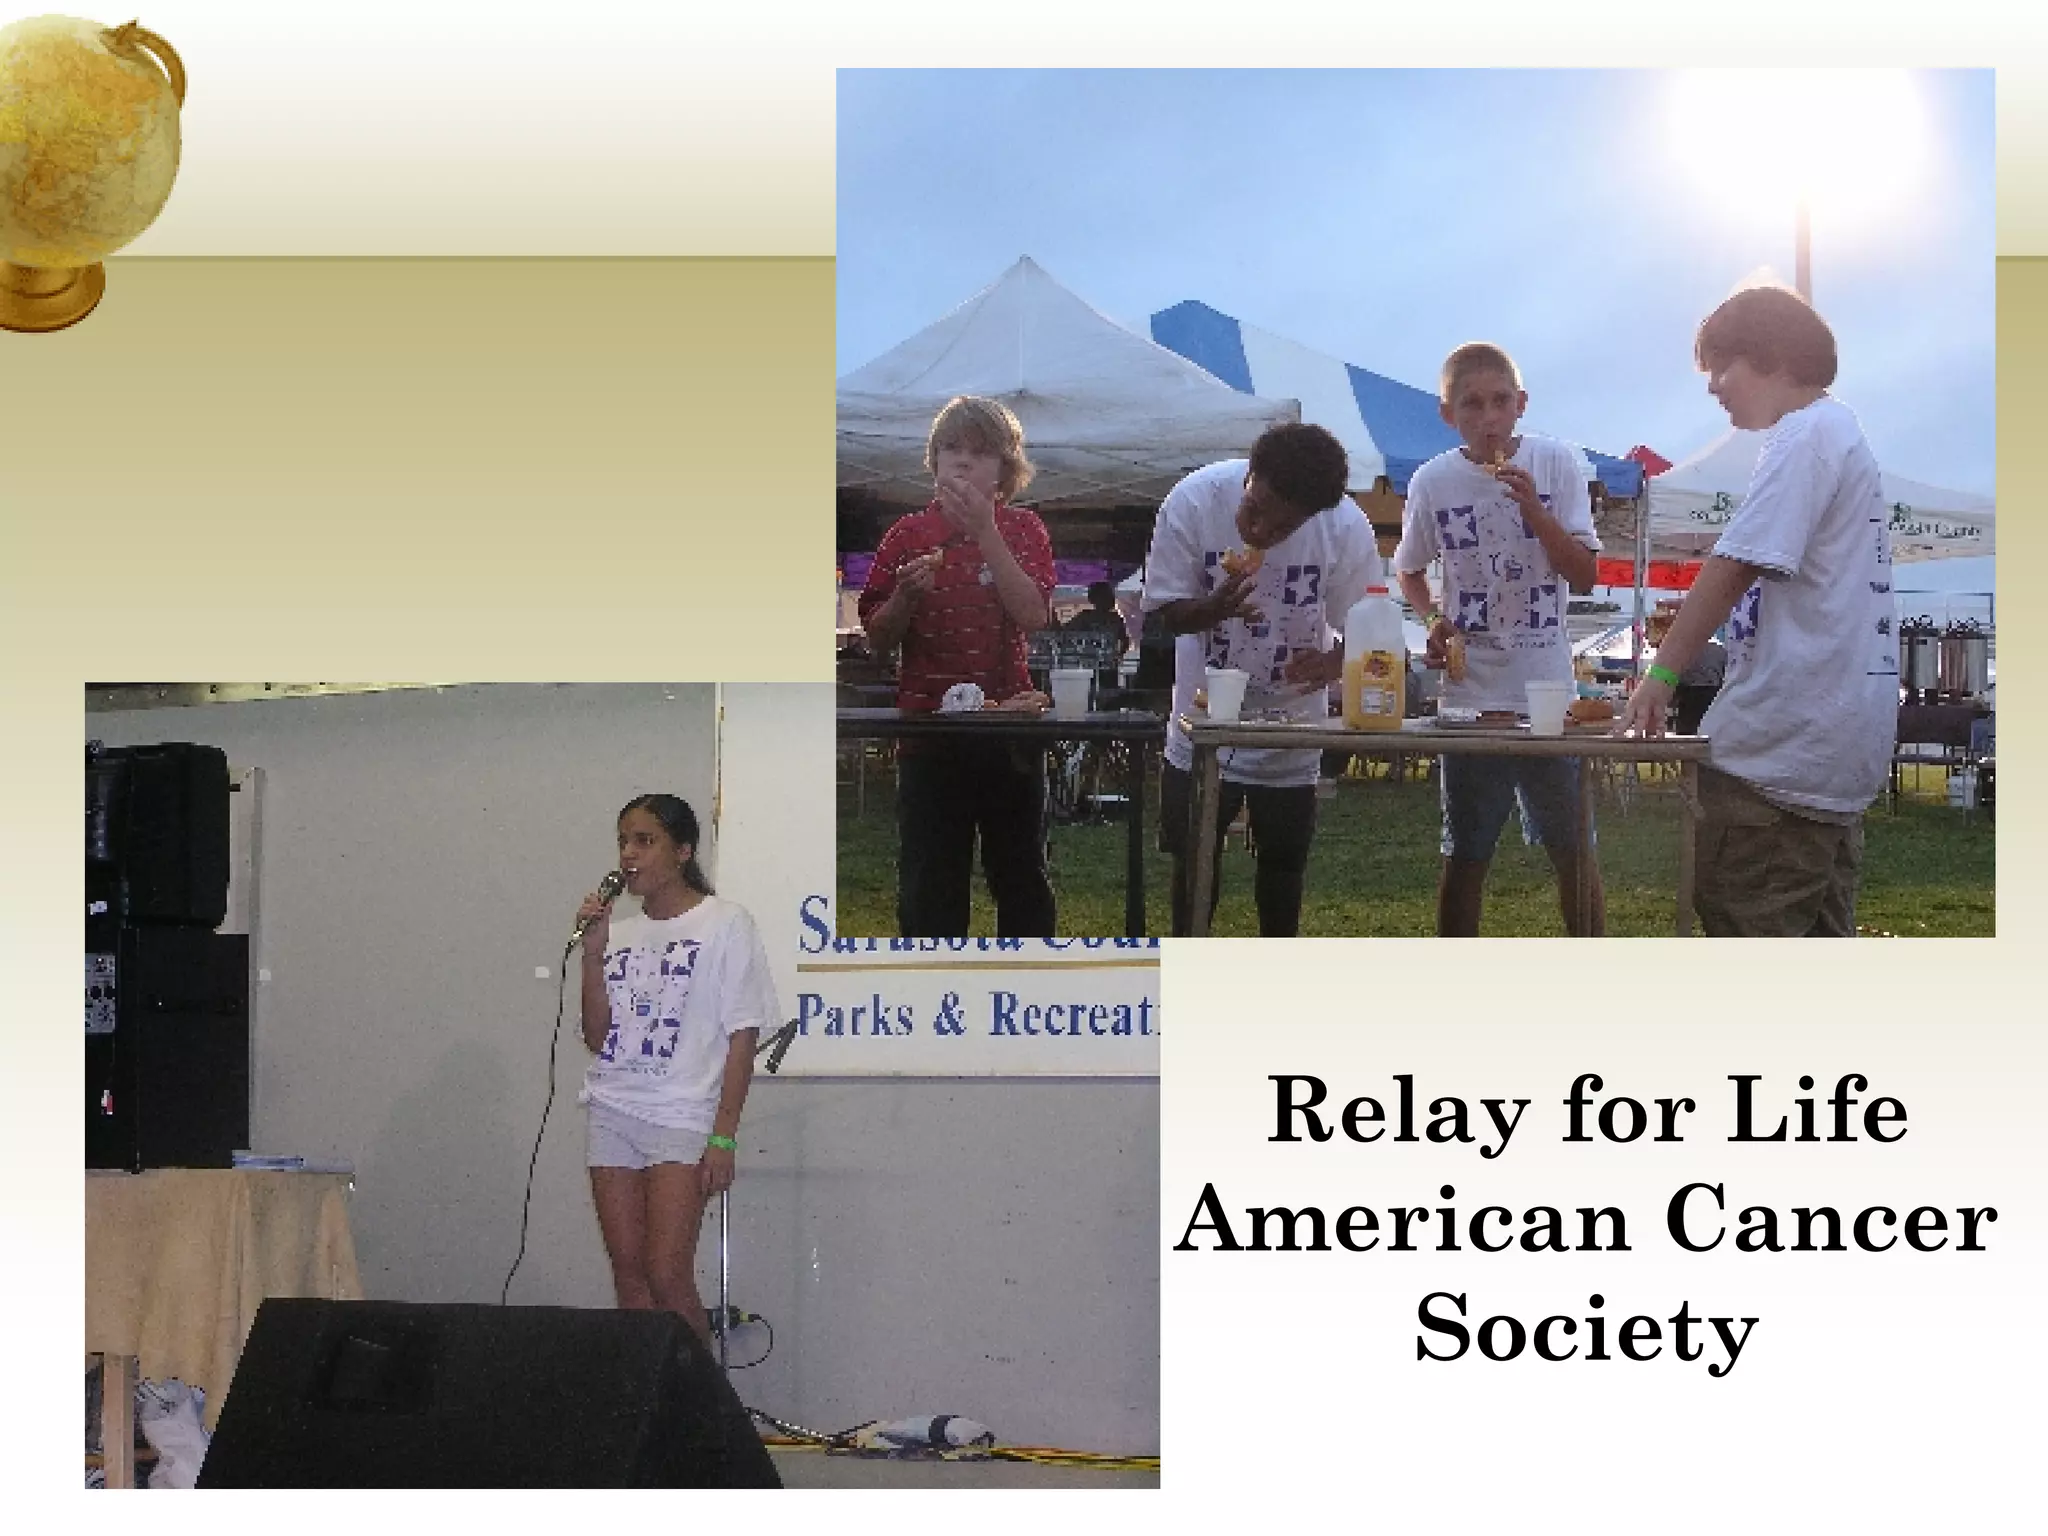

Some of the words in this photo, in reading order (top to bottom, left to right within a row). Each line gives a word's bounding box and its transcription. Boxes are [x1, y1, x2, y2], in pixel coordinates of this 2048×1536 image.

[797, 993, 913, 1037] Parks
[933, 991, 967, 1036] &
[988, 991, 1161, 1036] Recreat
